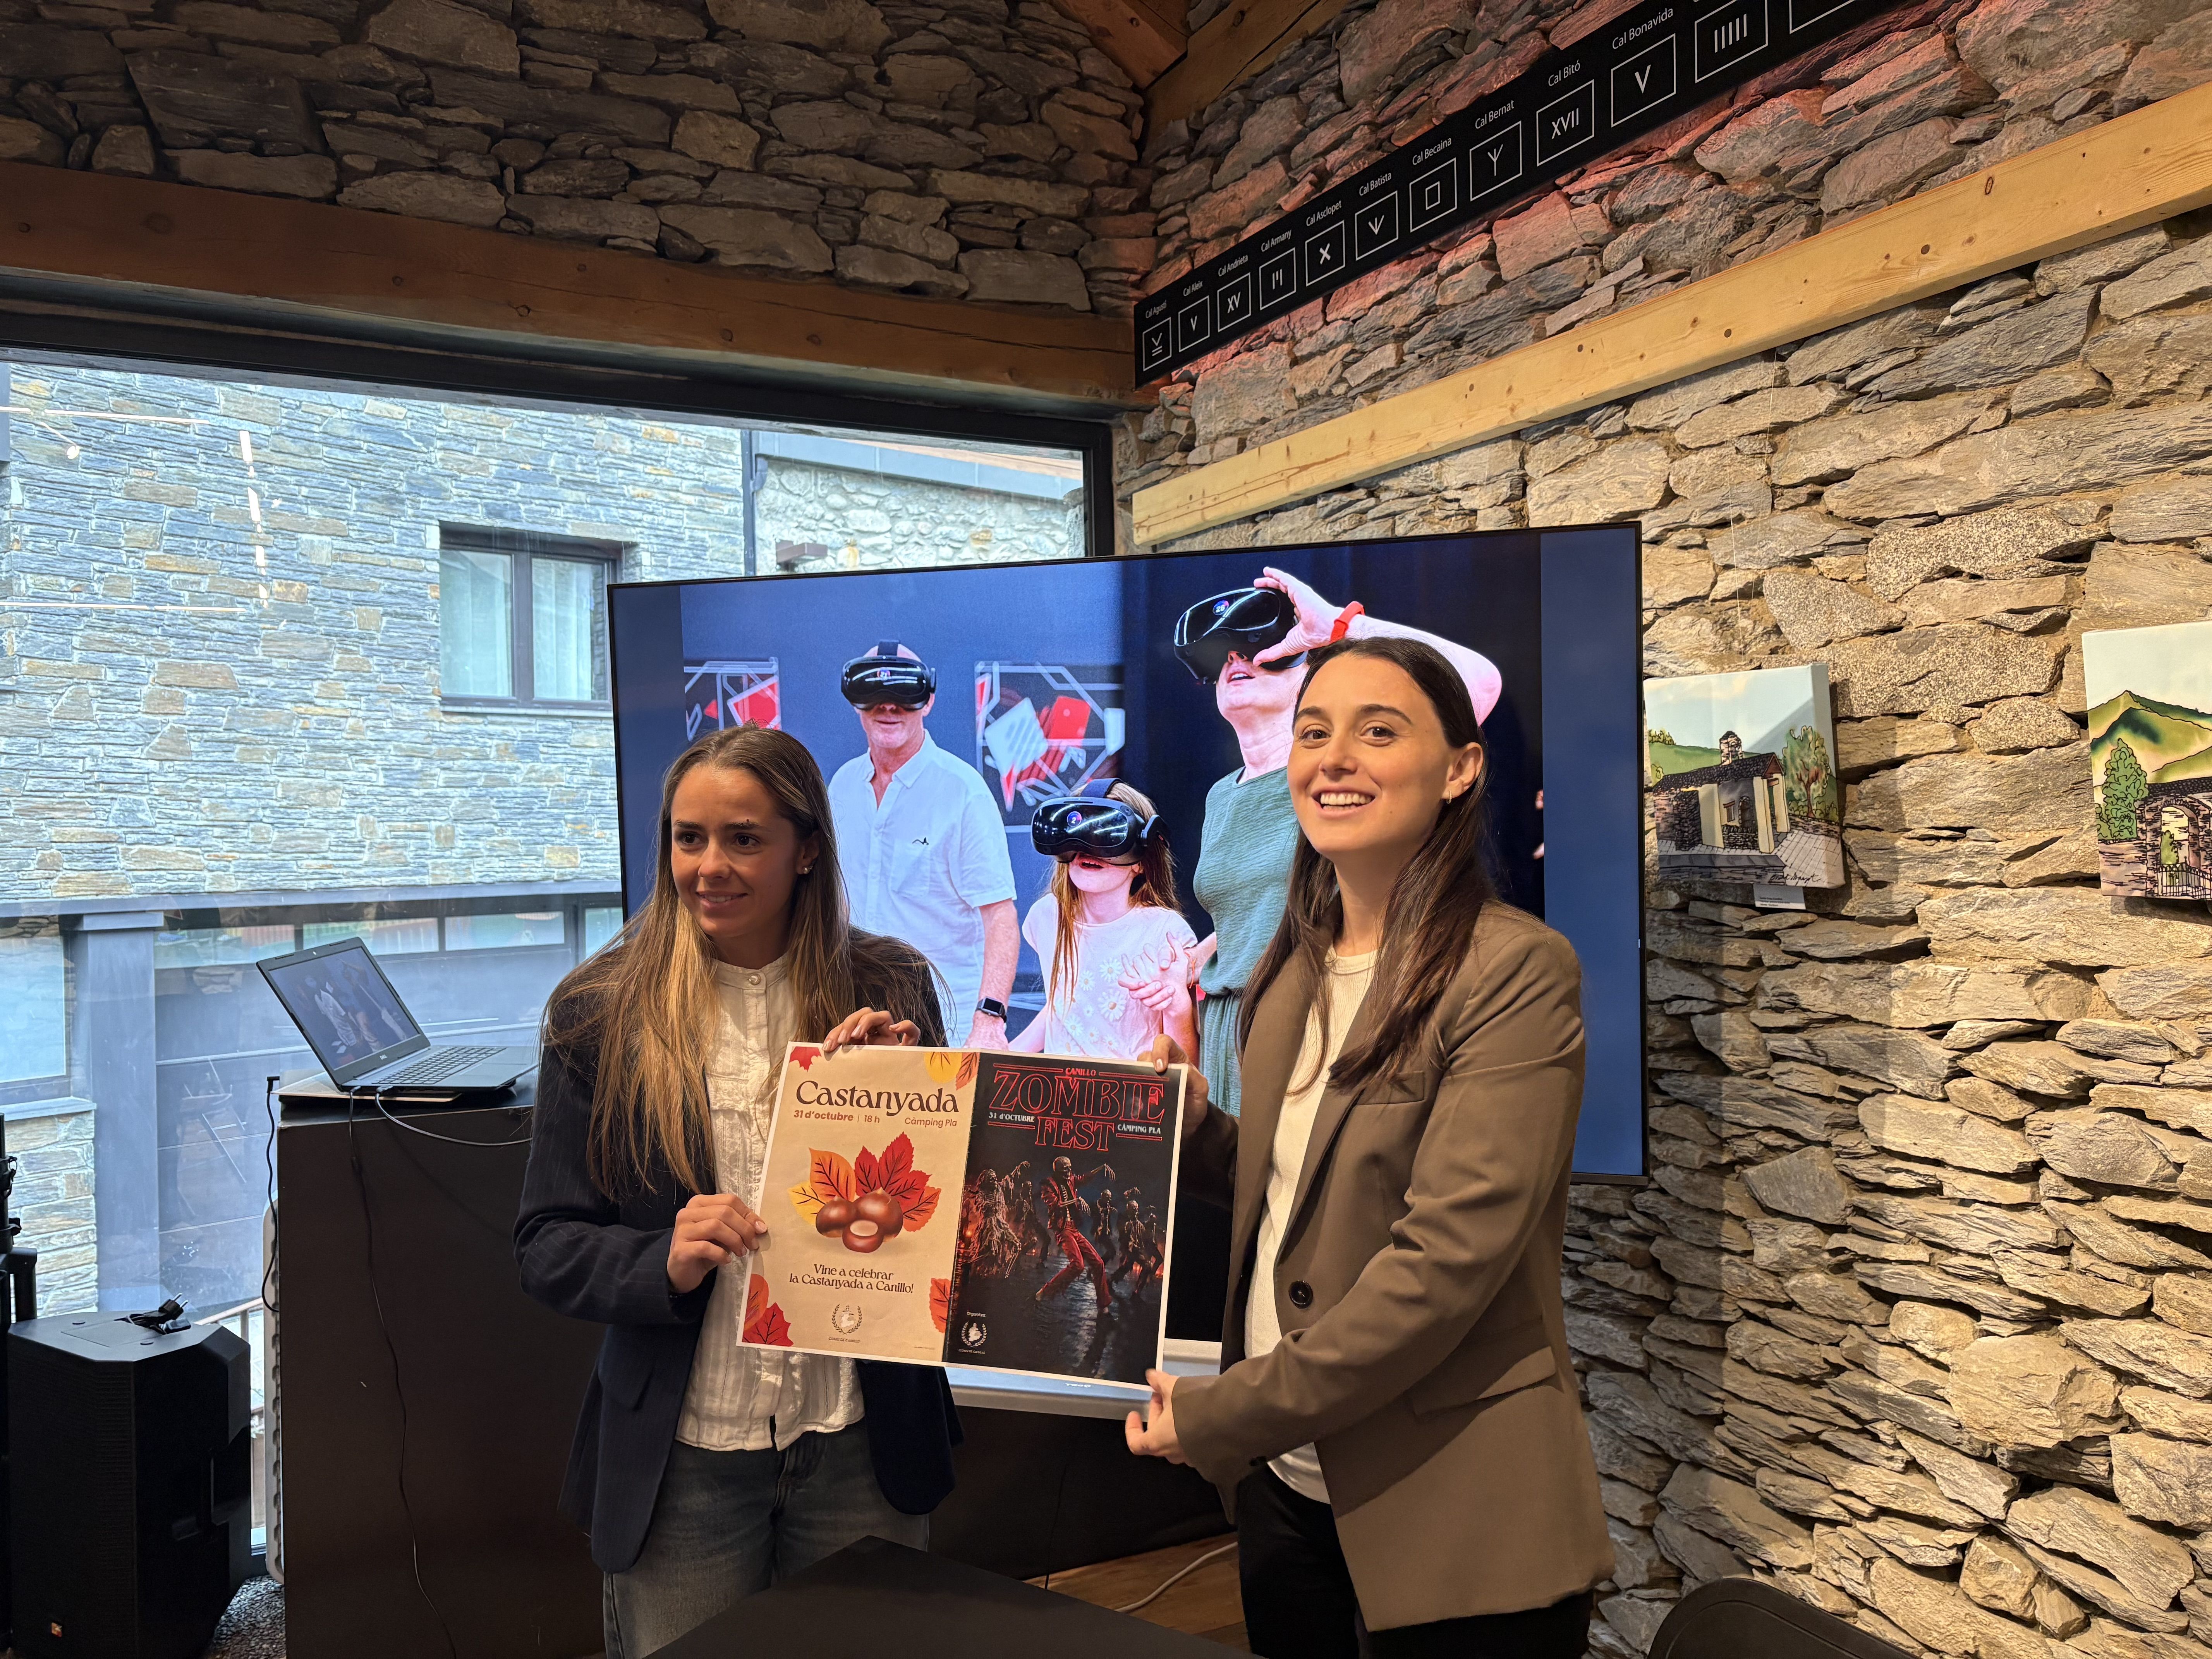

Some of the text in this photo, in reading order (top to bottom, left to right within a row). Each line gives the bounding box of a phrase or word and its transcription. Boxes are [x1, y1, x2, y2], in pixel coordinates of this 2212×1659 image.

[1612, 8, 1673, 49] Cal Bonavida
[1548, 59, 1581, 86] Cal Bitó
[1475, 100, 1515, 129] Cal Bernat
[1551, 107, 1579, 140] XVII
[1412, 137, 1452, 165] Cal Becaina
[1359, 172, 1392, 196] Cal Batista
[1306, 200, 1342, 227] Cal Asclopet
[1261, 229, 1292, 252] Cal Armany
[1218, 255, 1248, 277] Cal Andrieta
[1183, 281, 1203, 297] Cal Aleix
[1227, 292, 1241, 314] XV
[1216, 604, 1226, 613] 26
[1065, 1067, 1097, 1076] CANILLO
[796, 1080, 960, 1116] Castanyada
[988, 1070, 1166, 1125] ZOMBIE
[793, 1110, 803, 1118] 31
[804, 1110, 854, 1121] d'octubre
[904, 1116, 944, 1128] Càmping
[1034, 1116, 1115, 1152] FEST
[1148, 1126, 1161, 1135] PLA
[789, 1273, 914, 1293] la Castanyada a Canillo!
[814, 1264, 894, 1280] Vine a celebrar
